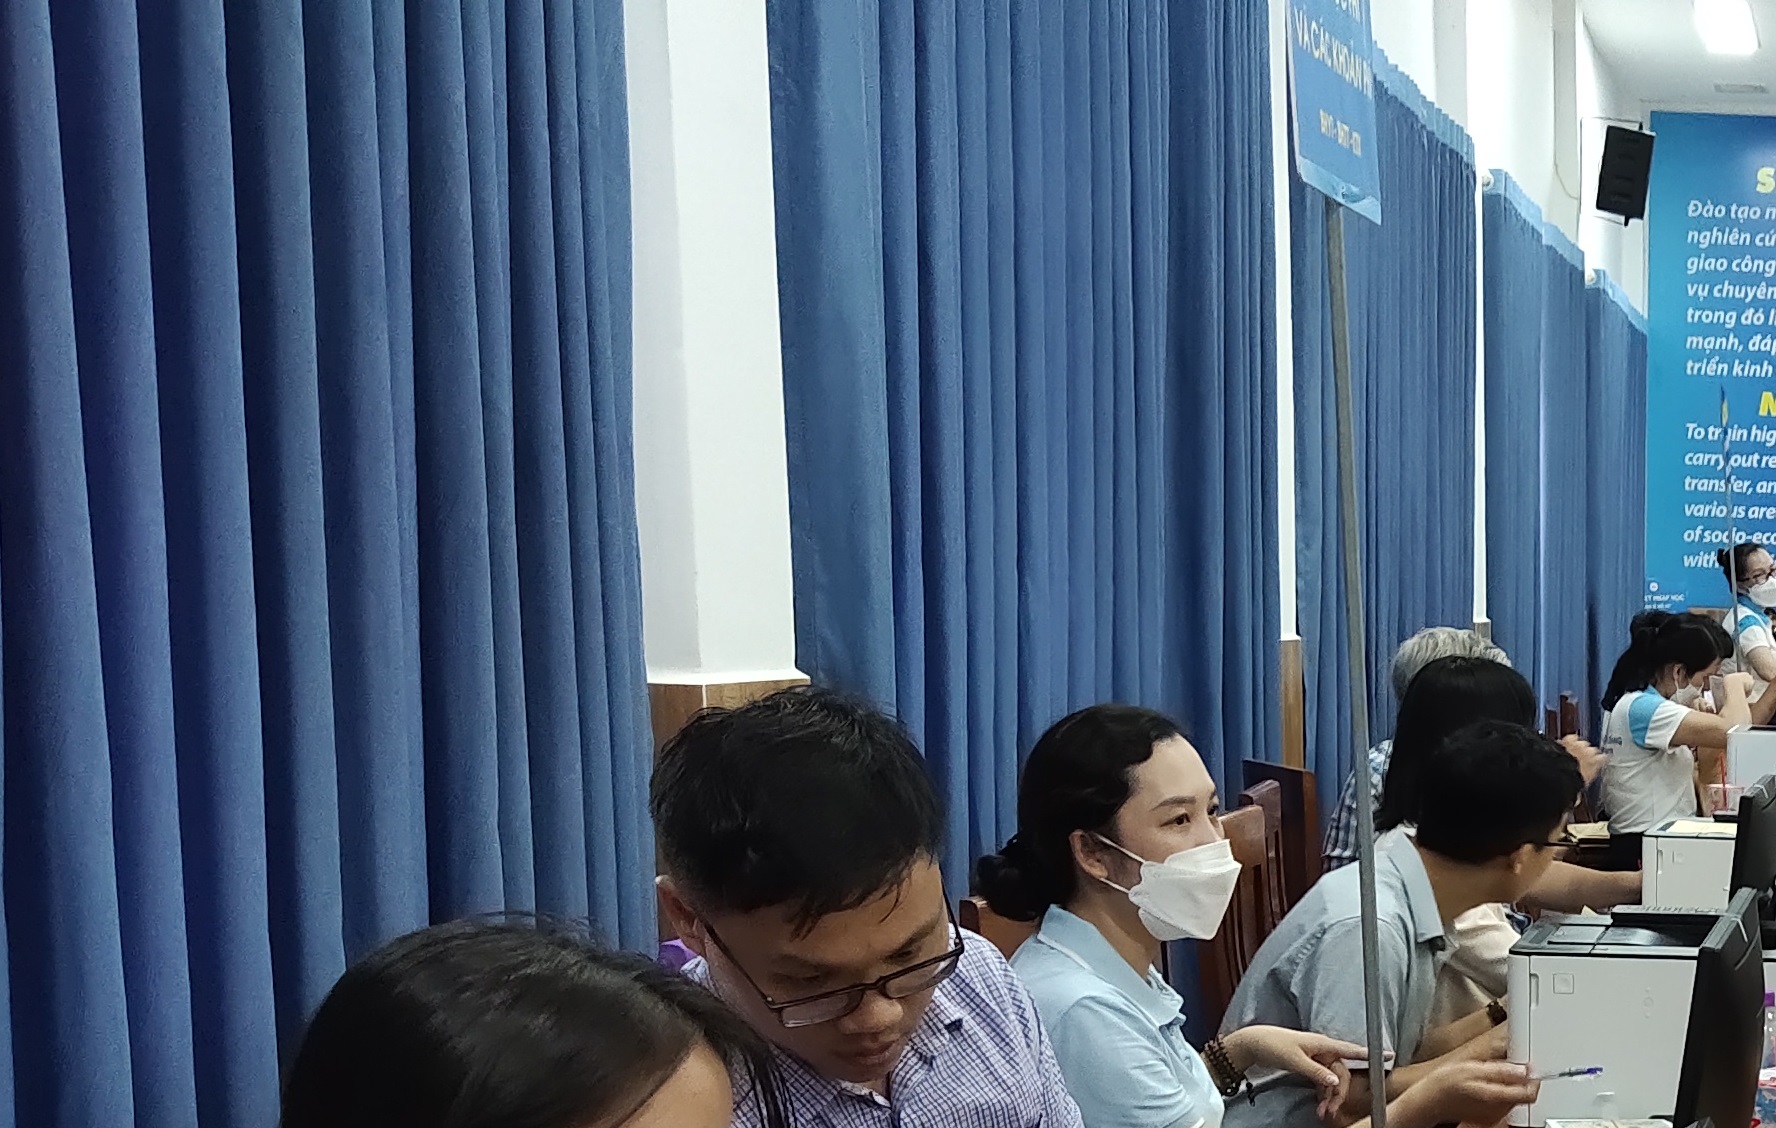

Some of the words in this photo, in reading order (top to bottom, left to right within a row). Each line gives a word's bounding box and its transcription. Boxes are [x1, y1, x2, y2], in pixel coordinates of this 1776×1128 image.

[1688, 200, 1725, 219] Đào
[1731, 205, 1760, 222] tạo
[1688, 228, 1750, 251] nghiên
[1687, 255, 1727, 275] giao
[1732, 256, 1776, 276] công
[1688, 285, 1709, 302] vụ
[1687, 308, 1736, 328] trong
[1742, 307, 1764, 325] đó
[1686, 334, 1743, 354] mạnh,
[1686, 359, 1729, 379] triển
[1733, 359, 1773, 379] kinh
[1730, 452, 1760, 468] out
[1683, 526, 1703, 543] of
[1683, 551, 1720, 569] with
